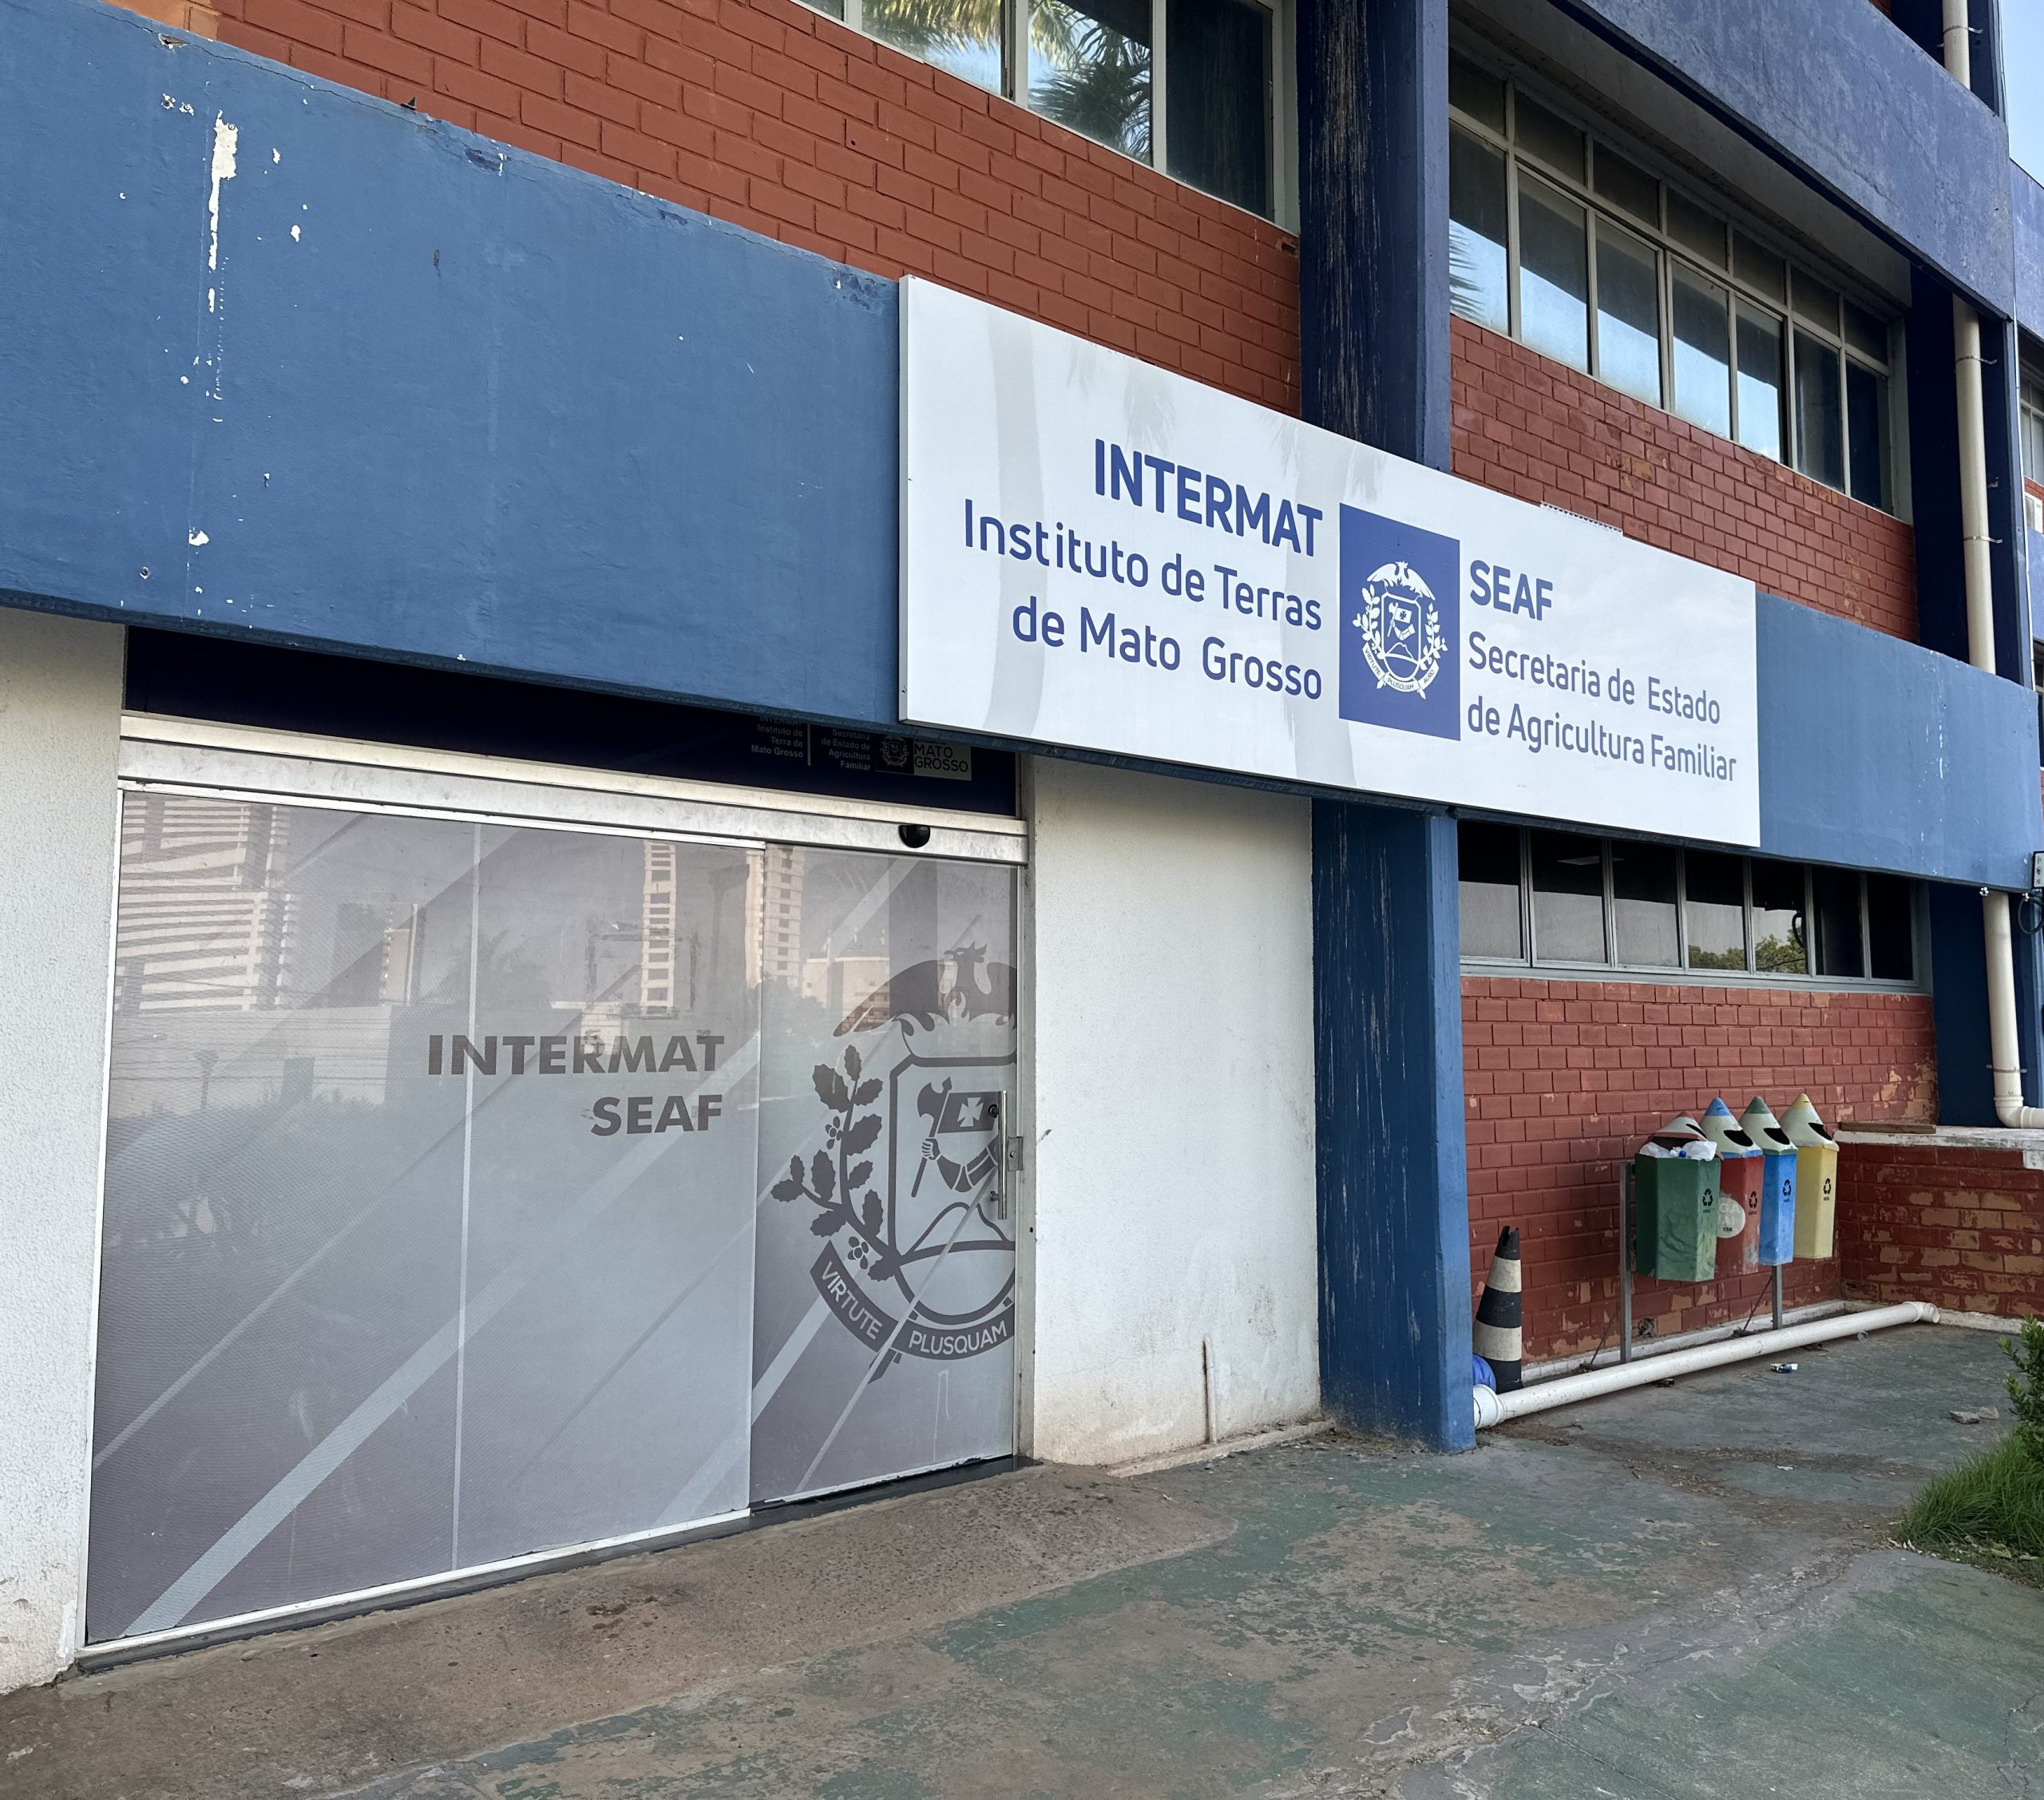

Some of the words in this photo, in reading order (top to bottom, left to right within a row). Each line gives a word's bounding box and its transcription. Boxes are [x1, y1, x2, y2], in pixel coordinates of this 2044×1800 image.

[1095, 438, 1323, 557] INTERMAT
[965, 498, 1148, 588] Instituto
[1161, 553, 1205, 602] de
[1214, 564, 1322, 631] Terras
[1469, 560, 1553, 621] SEAF
[1012, 595, 1064, 647] de
[1080, 606, 1181, 671] Mato
[1202, 636, 1322, 700] Grosso
[1364, 648, 1381, 676] VIRTUTE
[1387, 677, 1415, 690] PLUSQUAM
[1424, 669, 1436, 684] AURO
[1468, 631, 1601, 697] Secretaria
[1607, 668, 1635, 705] de
[1648, 676, 1721, 724] Estado
[757, 723, 791, 736] Instituto
[770, 735, 791, 746] Terra
[1468, 695, 1500, 735] de
[1507, 703, 1645, 764] Agricultura
[1651, 735, 1737, 781] Familiar
[751, 744, 772, 755] Mato
[774, 747, 804, 758] Grosso
[821, 737, 831, 747] de
[832, 738, 860, 750] Estado
[861, 742, 871, 751] de
[828, 747, 871, 761] Agricultura
[914, 743, 953, 758] MATO
[840, 759, 872, 771] Familiar
[914, 756, 969, 772] GROSSO
[428, 1034, 725, 1076] INTERMAT
[590, 1094, 723, 1136] SEAF
[821, 1261, 882, 1340] VIRTUTE
[908, 1320, 1008, 1355] PLUSQUAM
